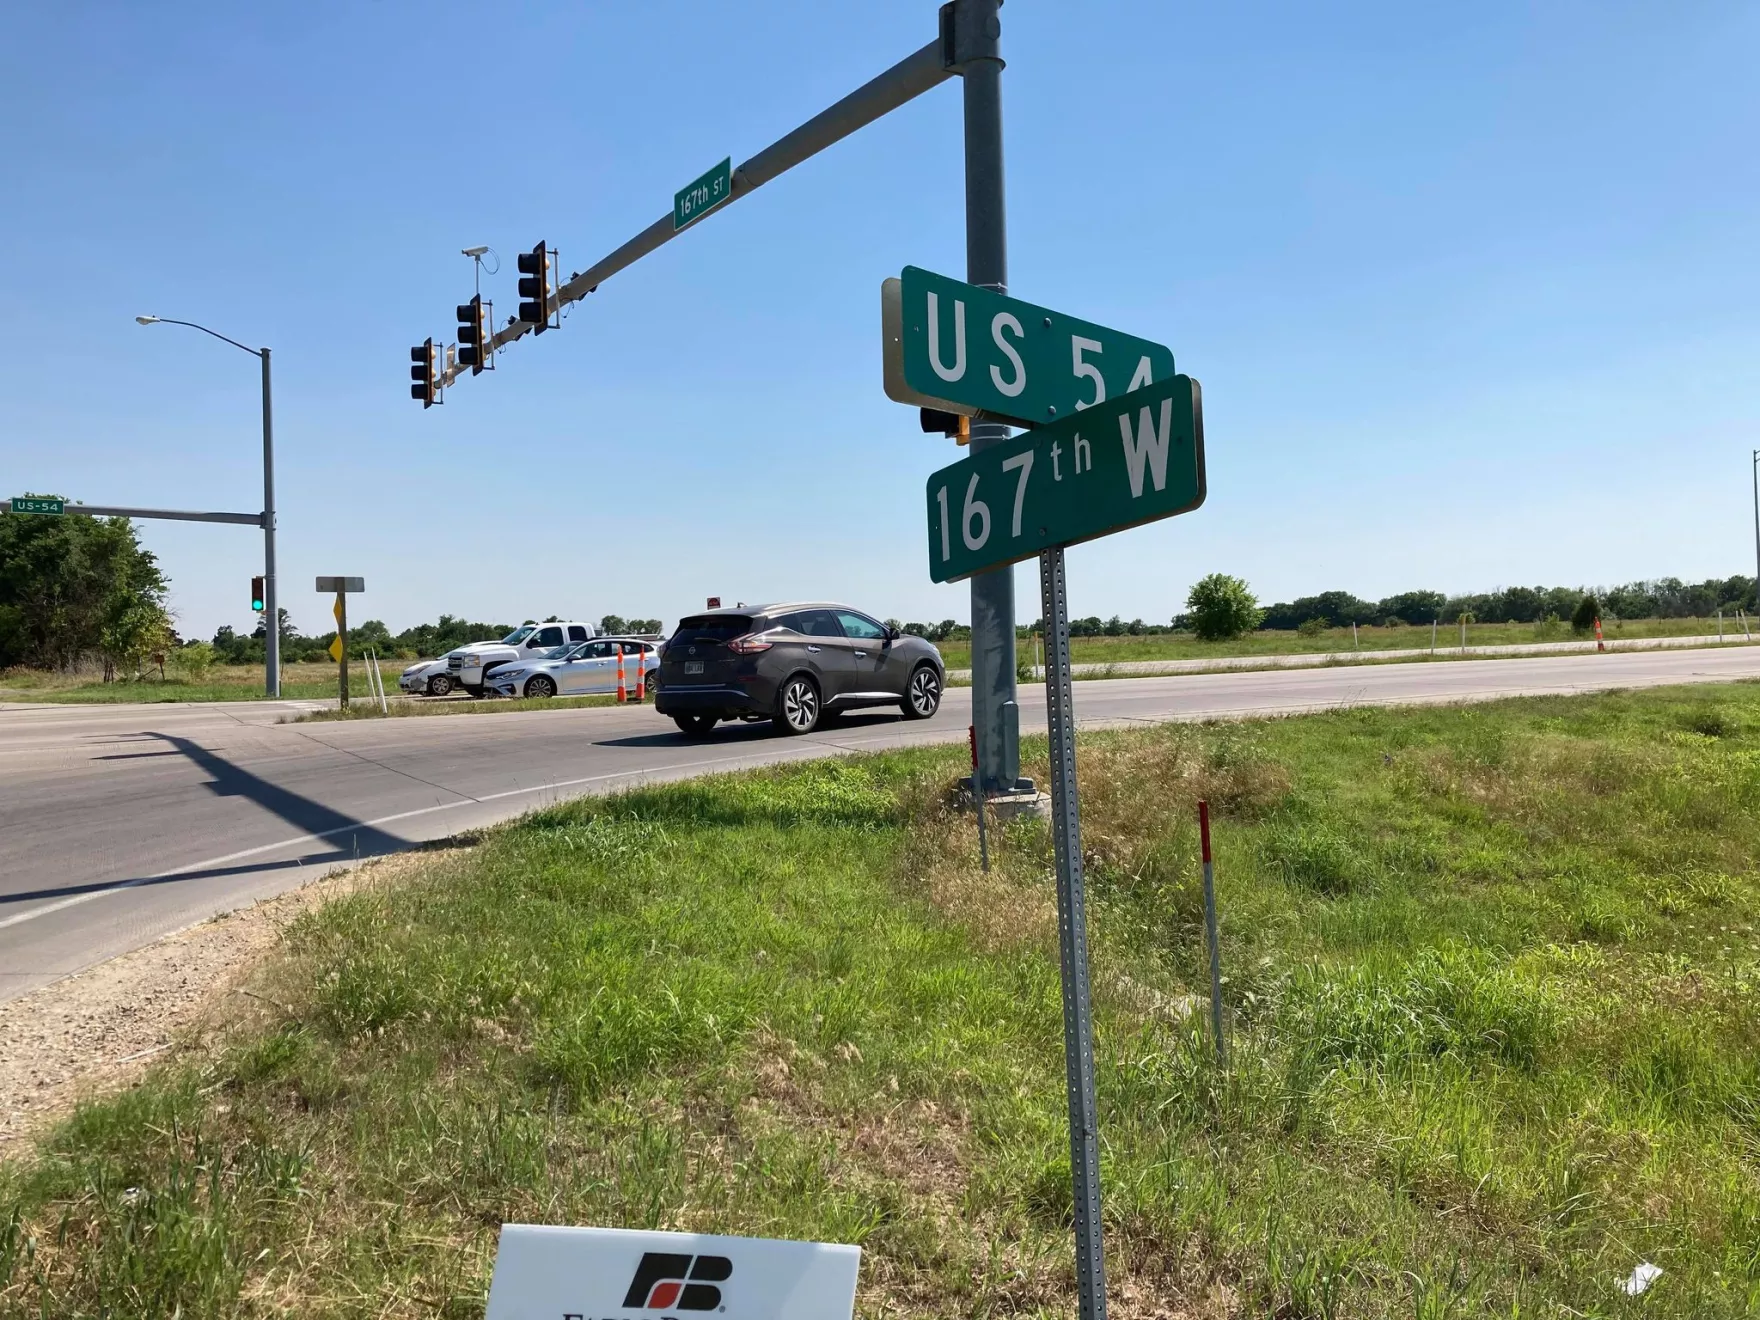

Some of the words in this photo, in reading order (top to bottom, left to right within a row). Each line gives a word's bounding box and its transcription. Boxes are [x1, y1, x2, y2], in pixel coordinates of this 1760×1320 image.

[681, 184, 709, 217] 167th
[713, 176, 724, 196] ST
[927, 291, 1027, 398] US
[17, 501, 58, 512] US-54
[936, 432, 1092, 562] 167th
[1118, 397, 1173, 499] W
